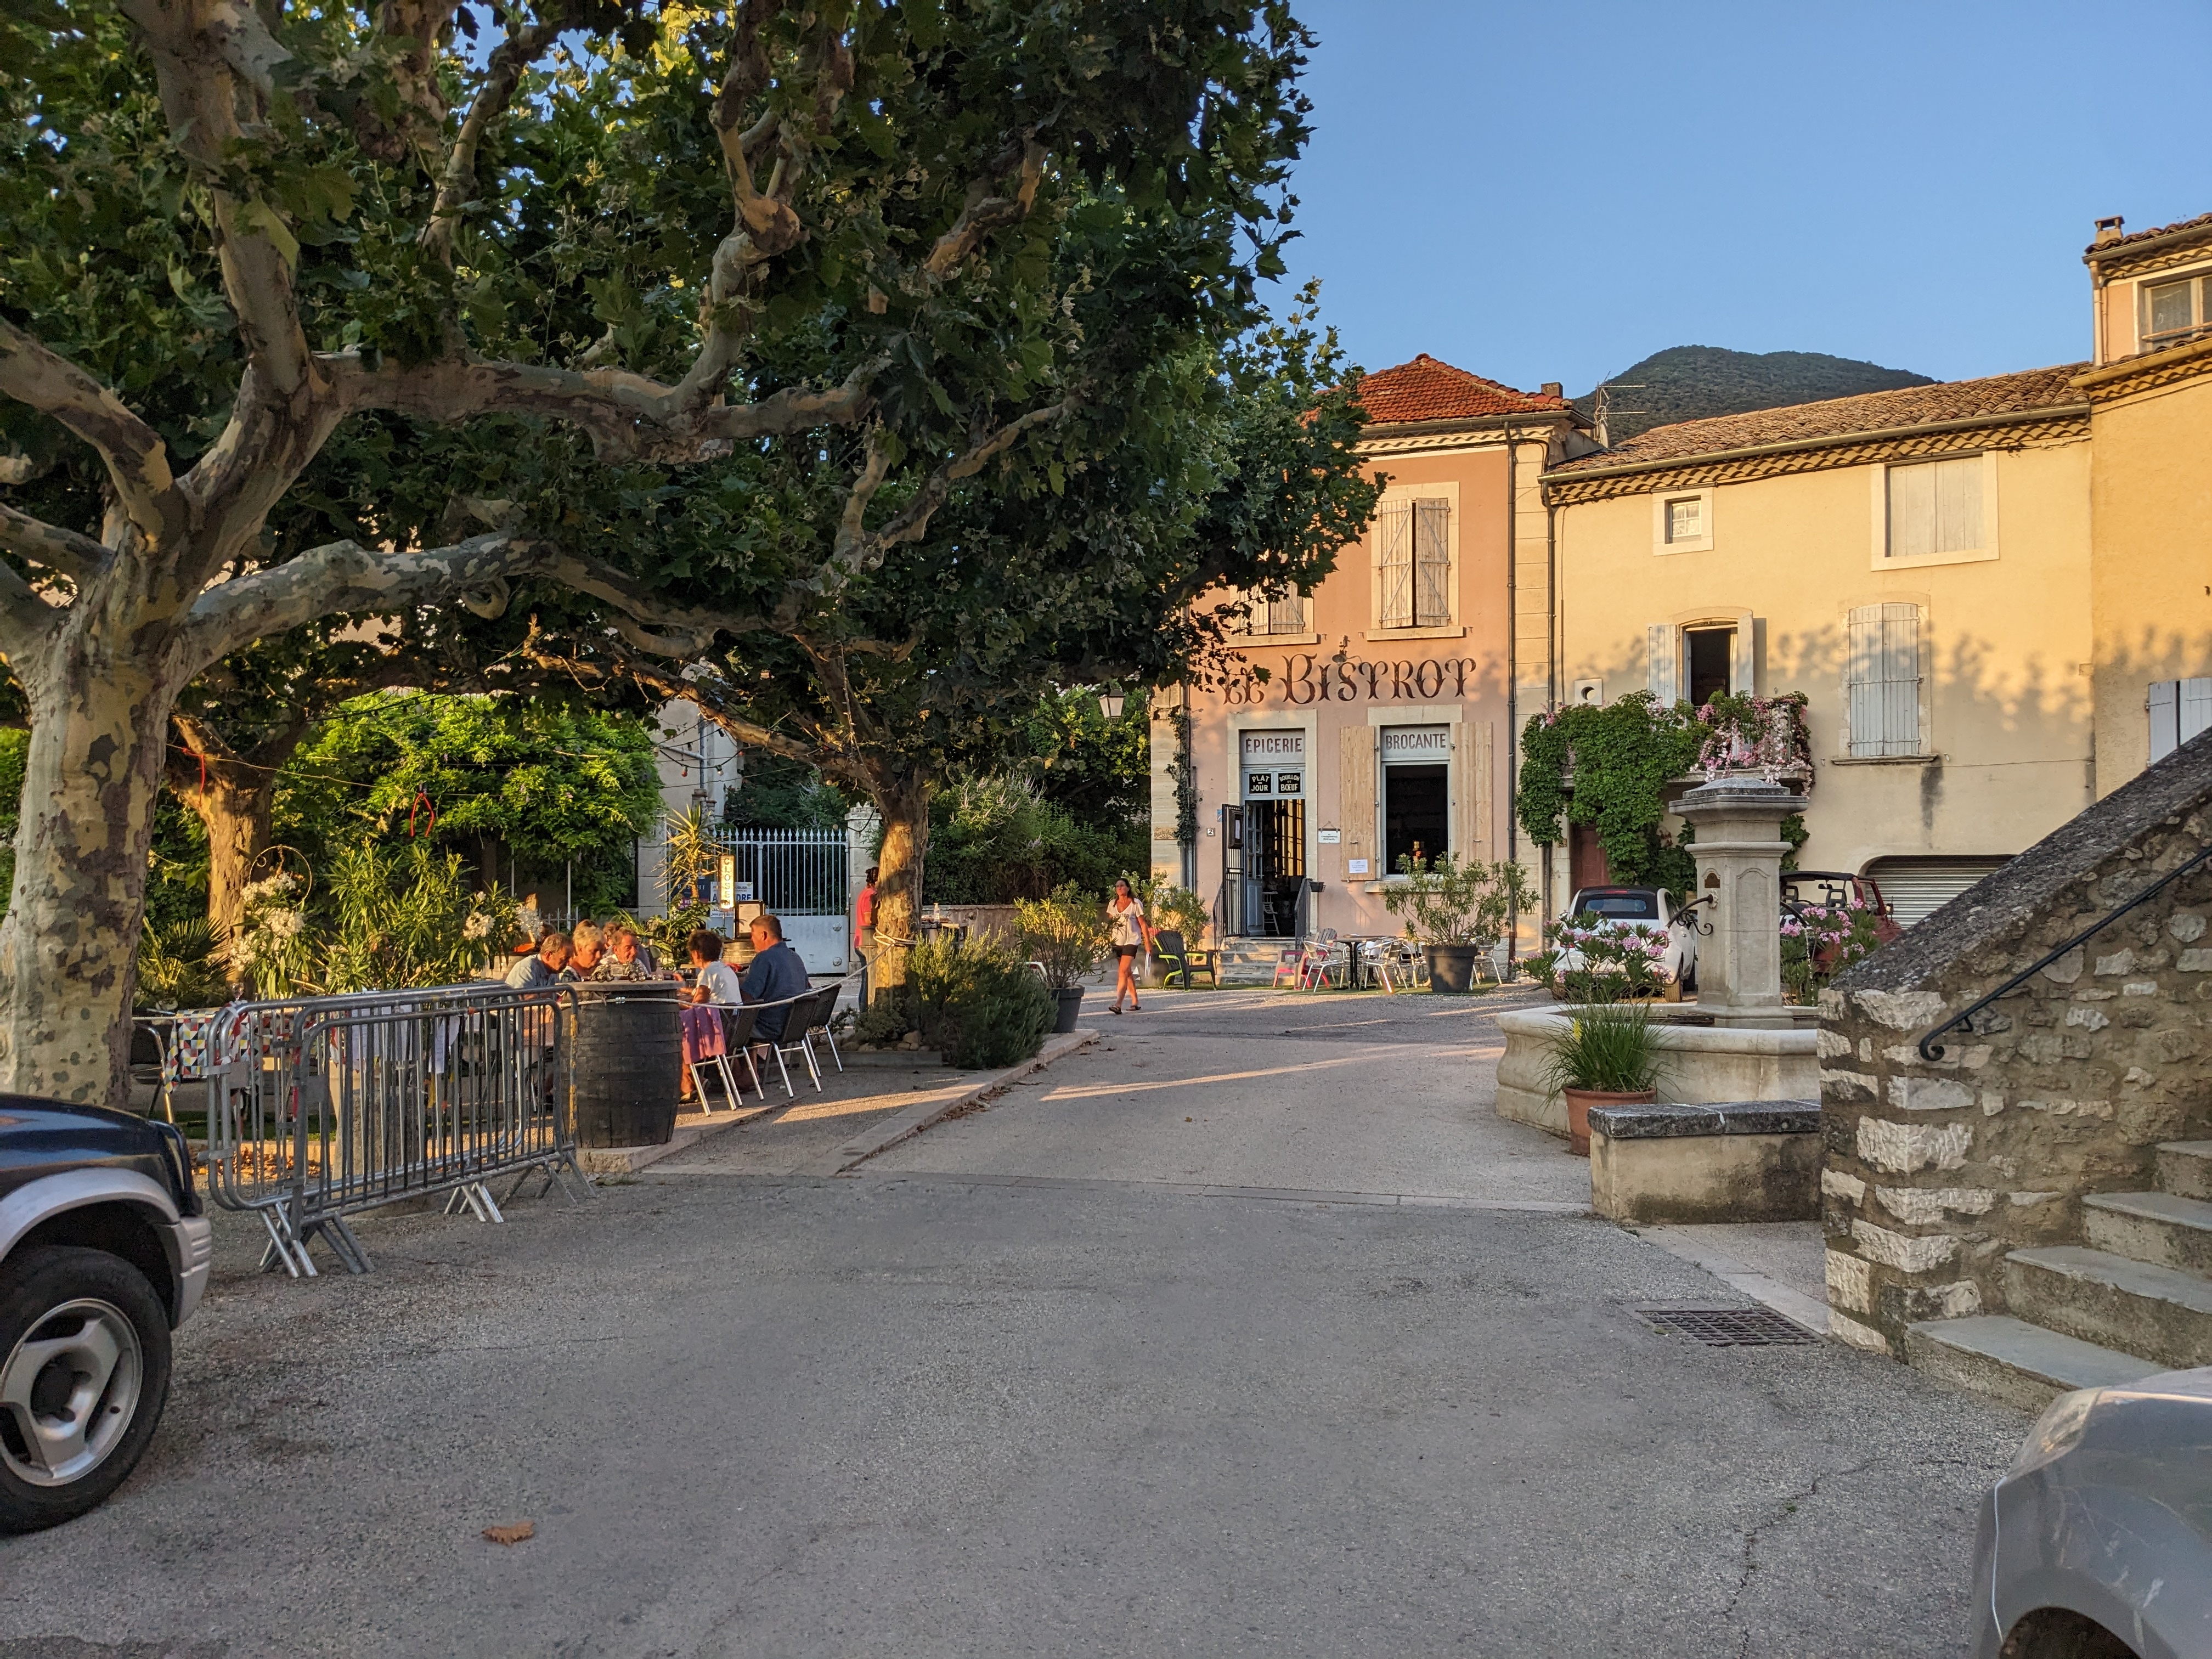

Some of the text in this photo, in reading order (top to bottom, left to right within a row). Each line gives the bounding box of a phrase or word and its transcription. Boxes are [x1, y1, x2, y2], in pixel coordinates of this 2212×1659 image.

[1220, 653, 1476, 704] LE BISTROT
[1245, 738, 1302, 754] ÉPICERIE
[1385, 733, 1446, 750] BROCANTE
[1279, 774, 1300, 782] BOUILLON
